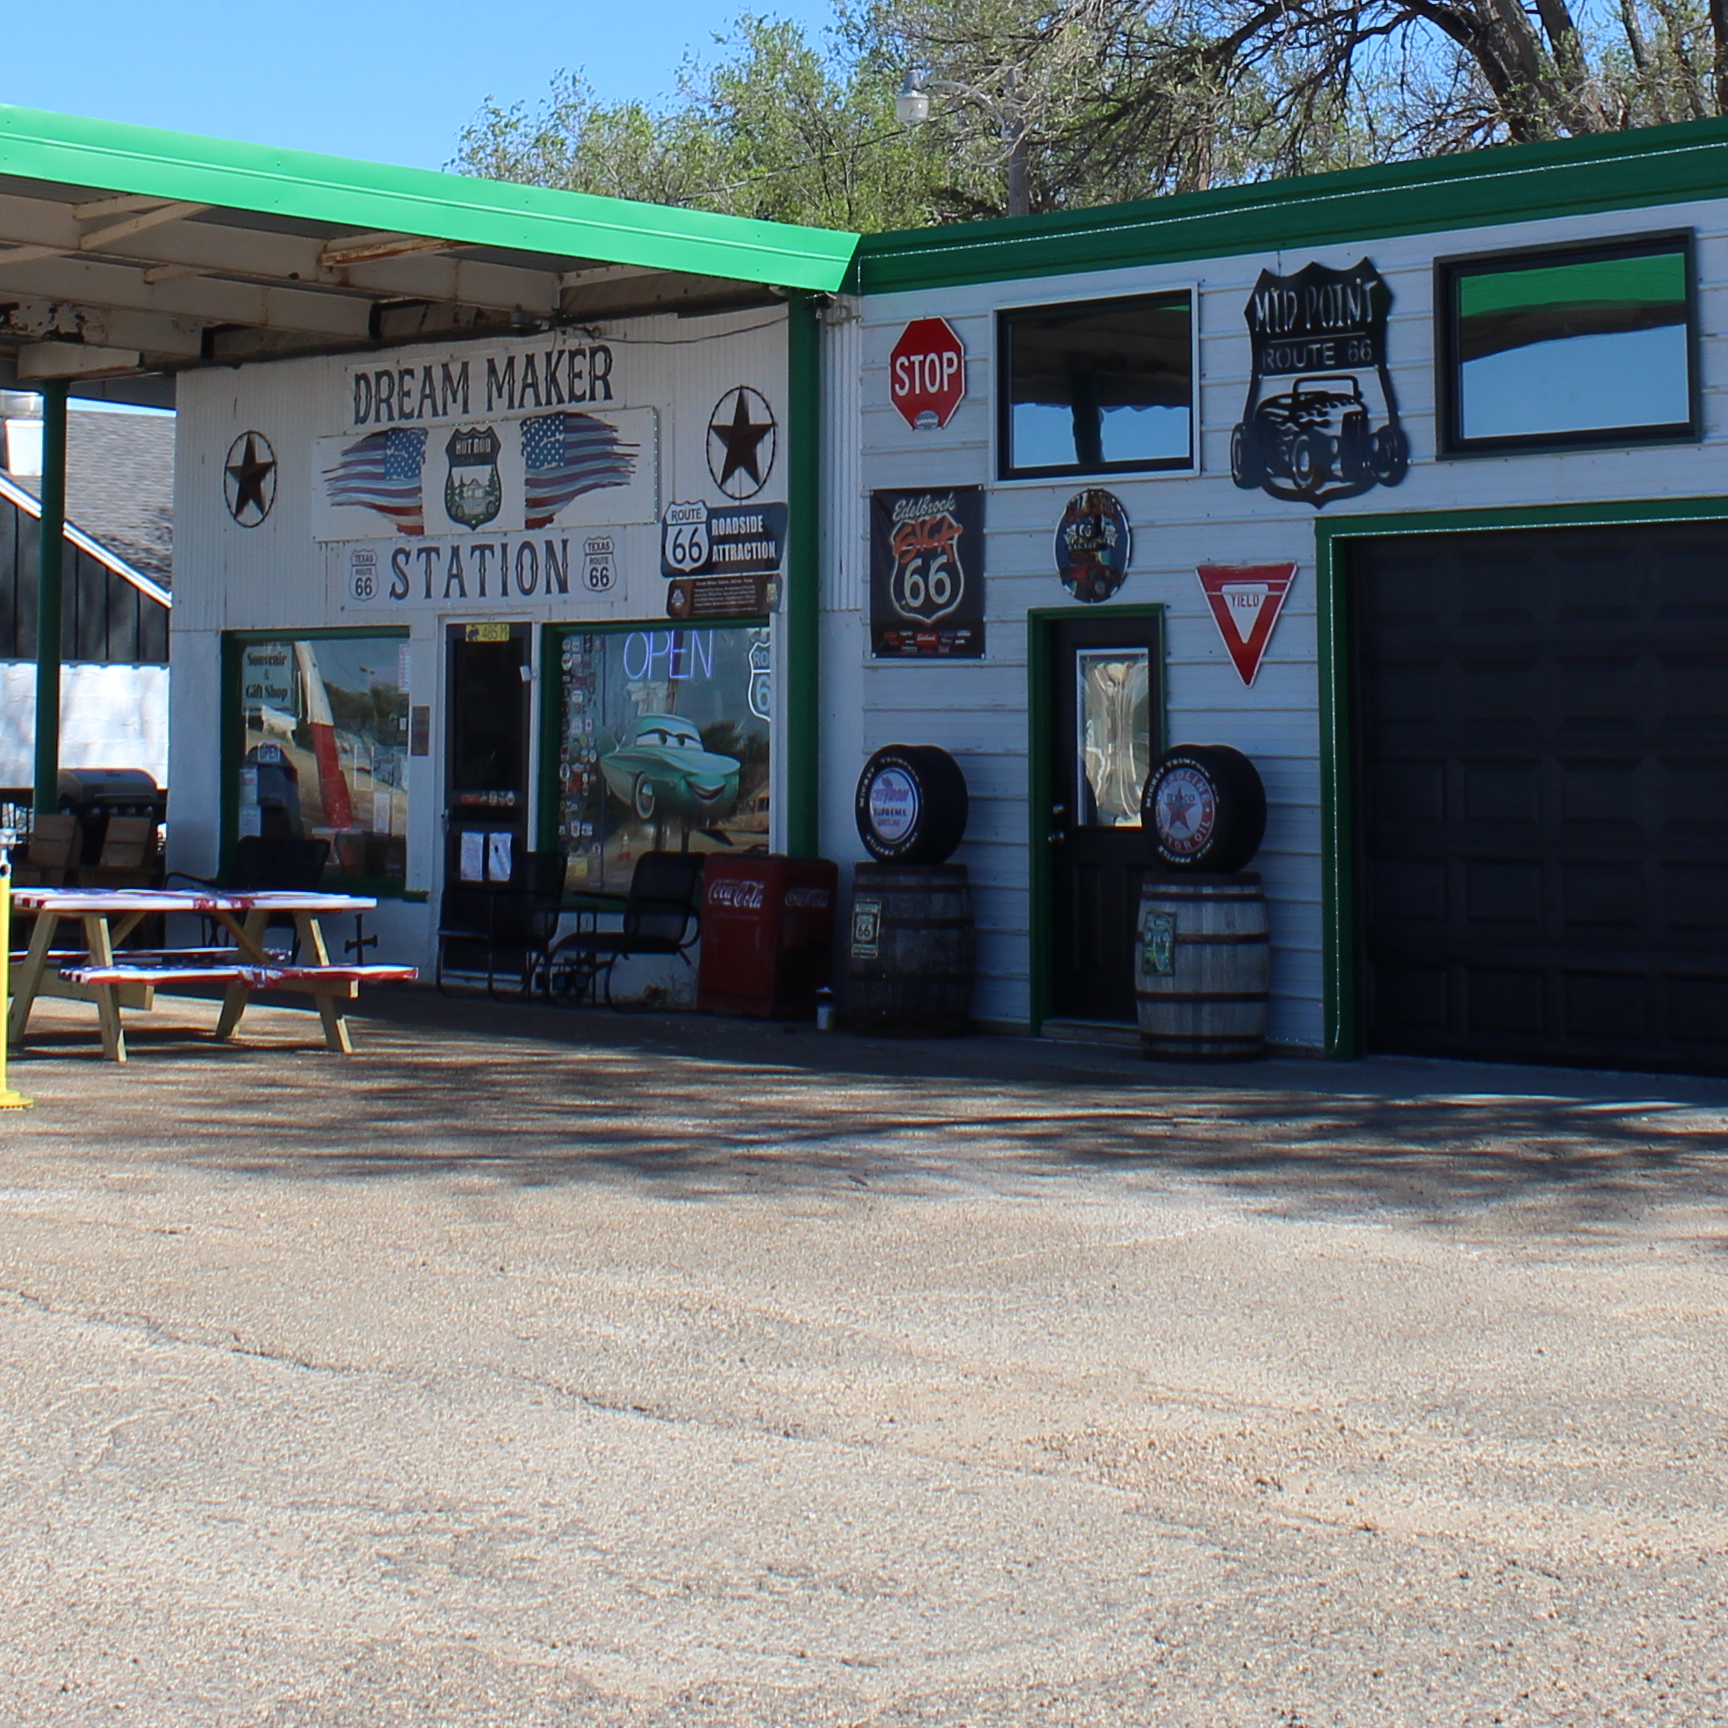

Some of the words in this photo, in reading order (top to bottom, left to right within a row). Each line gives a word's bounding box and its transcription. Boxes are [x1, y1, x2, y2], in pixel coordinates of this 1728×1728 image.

[1255, 289, 1297, 333] MID
[1306, 280, 1378, 330] POINT
[1263, 342, 1335, 369] ROUTE
[1347, 339, 1372, 362] 66
[354, 360, 470, 425] DREAM
[486, 344, 613, 412] MAKER
[894, 351, 959, 396] STOP
[455, 439, 472, 455] HOT
[671, 508, 702, 522] ROUTE
[892, 491, 956, 521] Edelbrock
[712, 515, 763, 536] ROADSIDE
[588, 541, 610, 552] TEXAS
[673, 526, 703, 565] 66
[712, 540, 776, 562] ATTRACTION
[389, 538, 570, 600] STATION
[589, 566, 610, 587] 66
[904, 554, 951, 607] 66
[355, 577, 373, 596] 66
[1231, 593, 1260, 607] YIELD
[247, 652, 288, 666] Souvenir
[624, 629, 712, 679] OPEN
[246, 683, 263, 698] Gift
[265, 683, 288, 702] Shop
[756, 674, 770, 711] 6
[709, 879, 764, 909] Coca-Cola
[859, 924, 871, 938] 66
